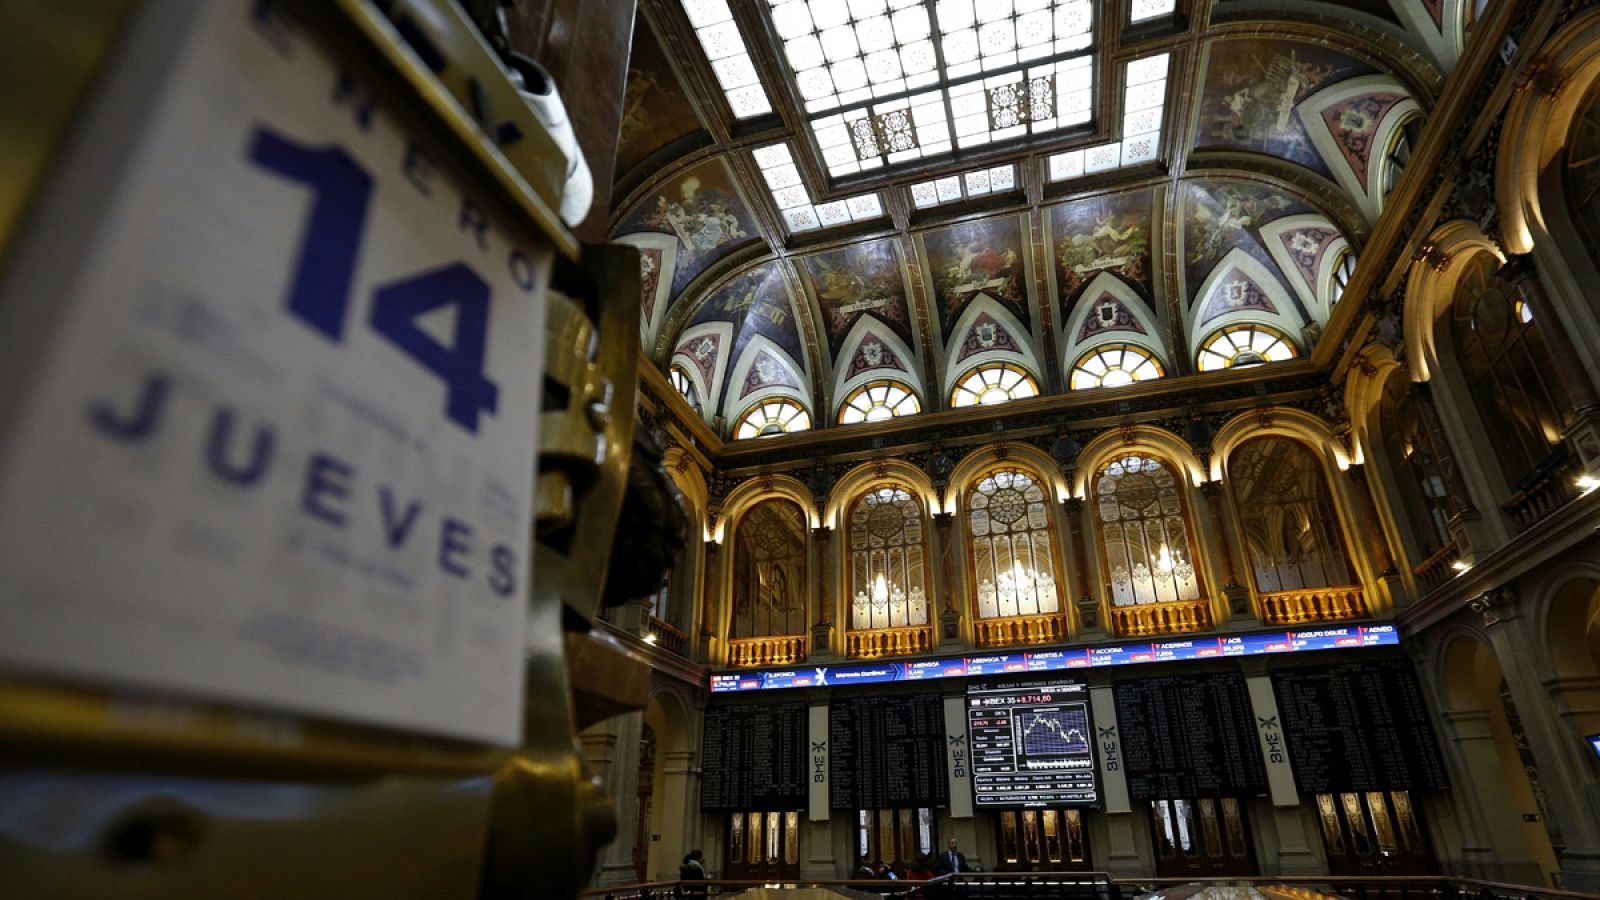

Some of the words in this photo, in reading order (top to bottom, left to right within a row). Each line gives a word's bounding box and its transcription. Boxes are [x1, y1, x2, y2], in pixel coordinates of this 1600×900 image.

[246, 122, 498, 434] 14
[88, 374, 517, 597] JUEVES
[952, 749, 966, 778] BME
[1103, 741, 1118, 772] BME
[1264, 731, 1284, 764] BME
[814, 755, 825, 783] BME
